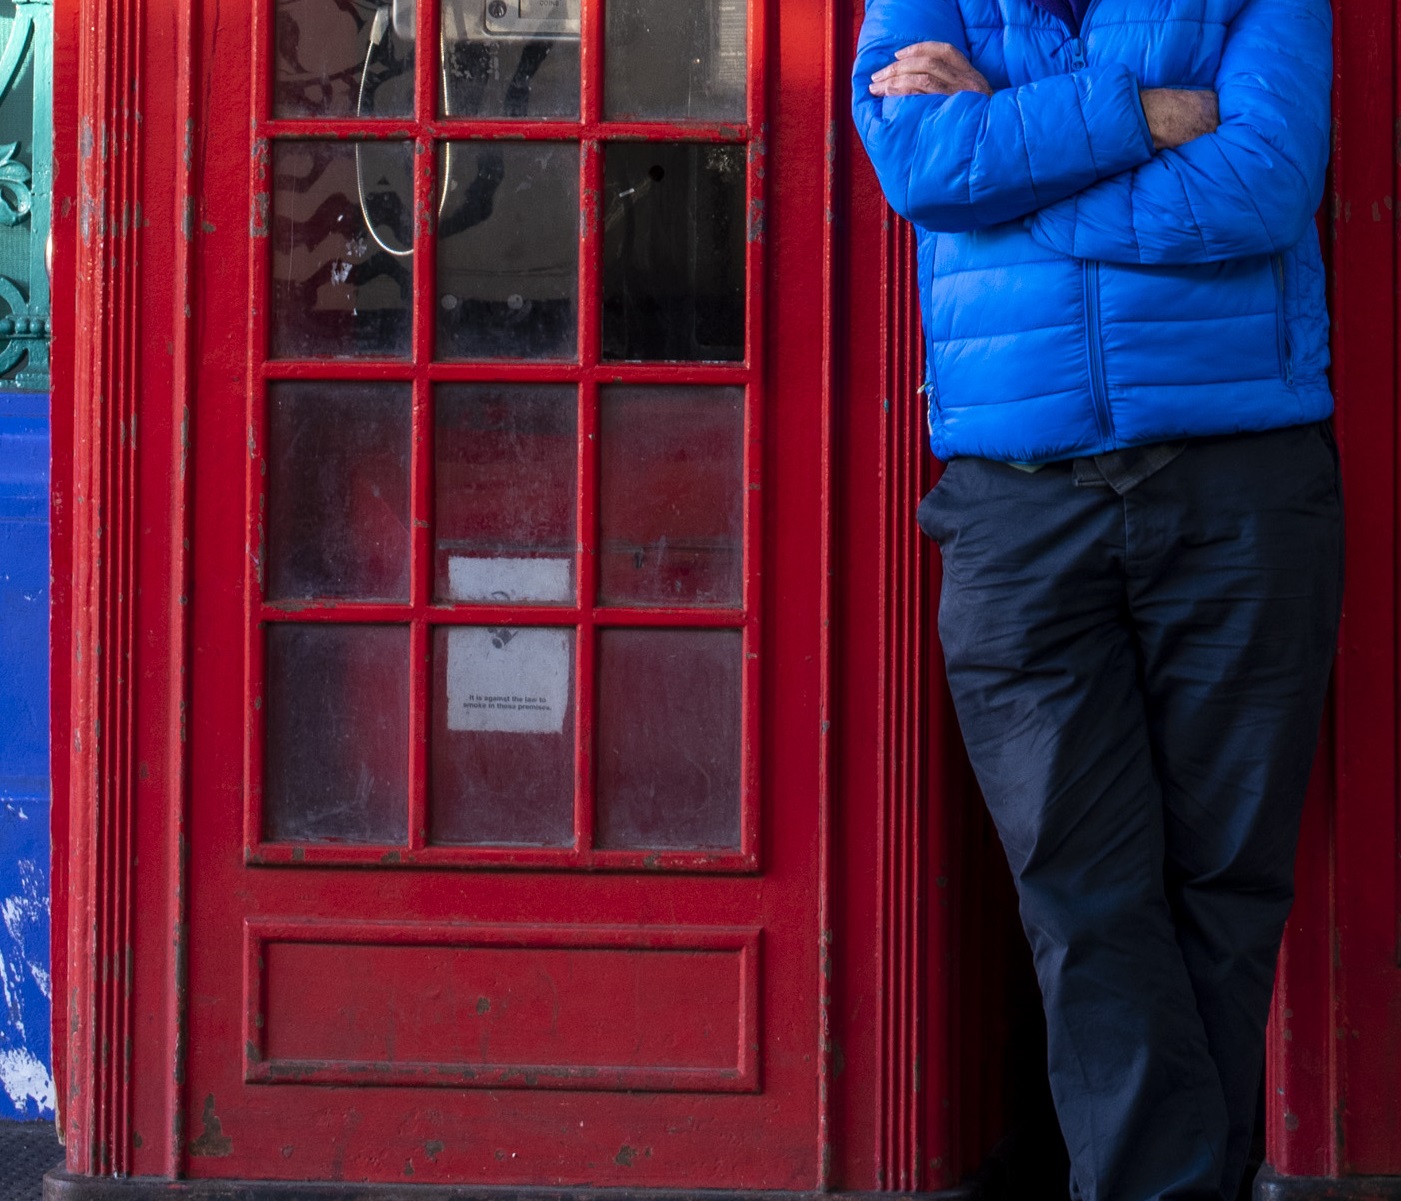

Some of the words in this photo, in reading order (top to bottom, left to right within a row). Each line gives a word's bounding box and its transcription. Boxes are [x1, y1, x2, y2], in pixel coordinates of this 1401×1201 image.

[484, 695, 510, 703] against
[511, 695, 523, 703] the
[517, 704, 552, 712] premises.
